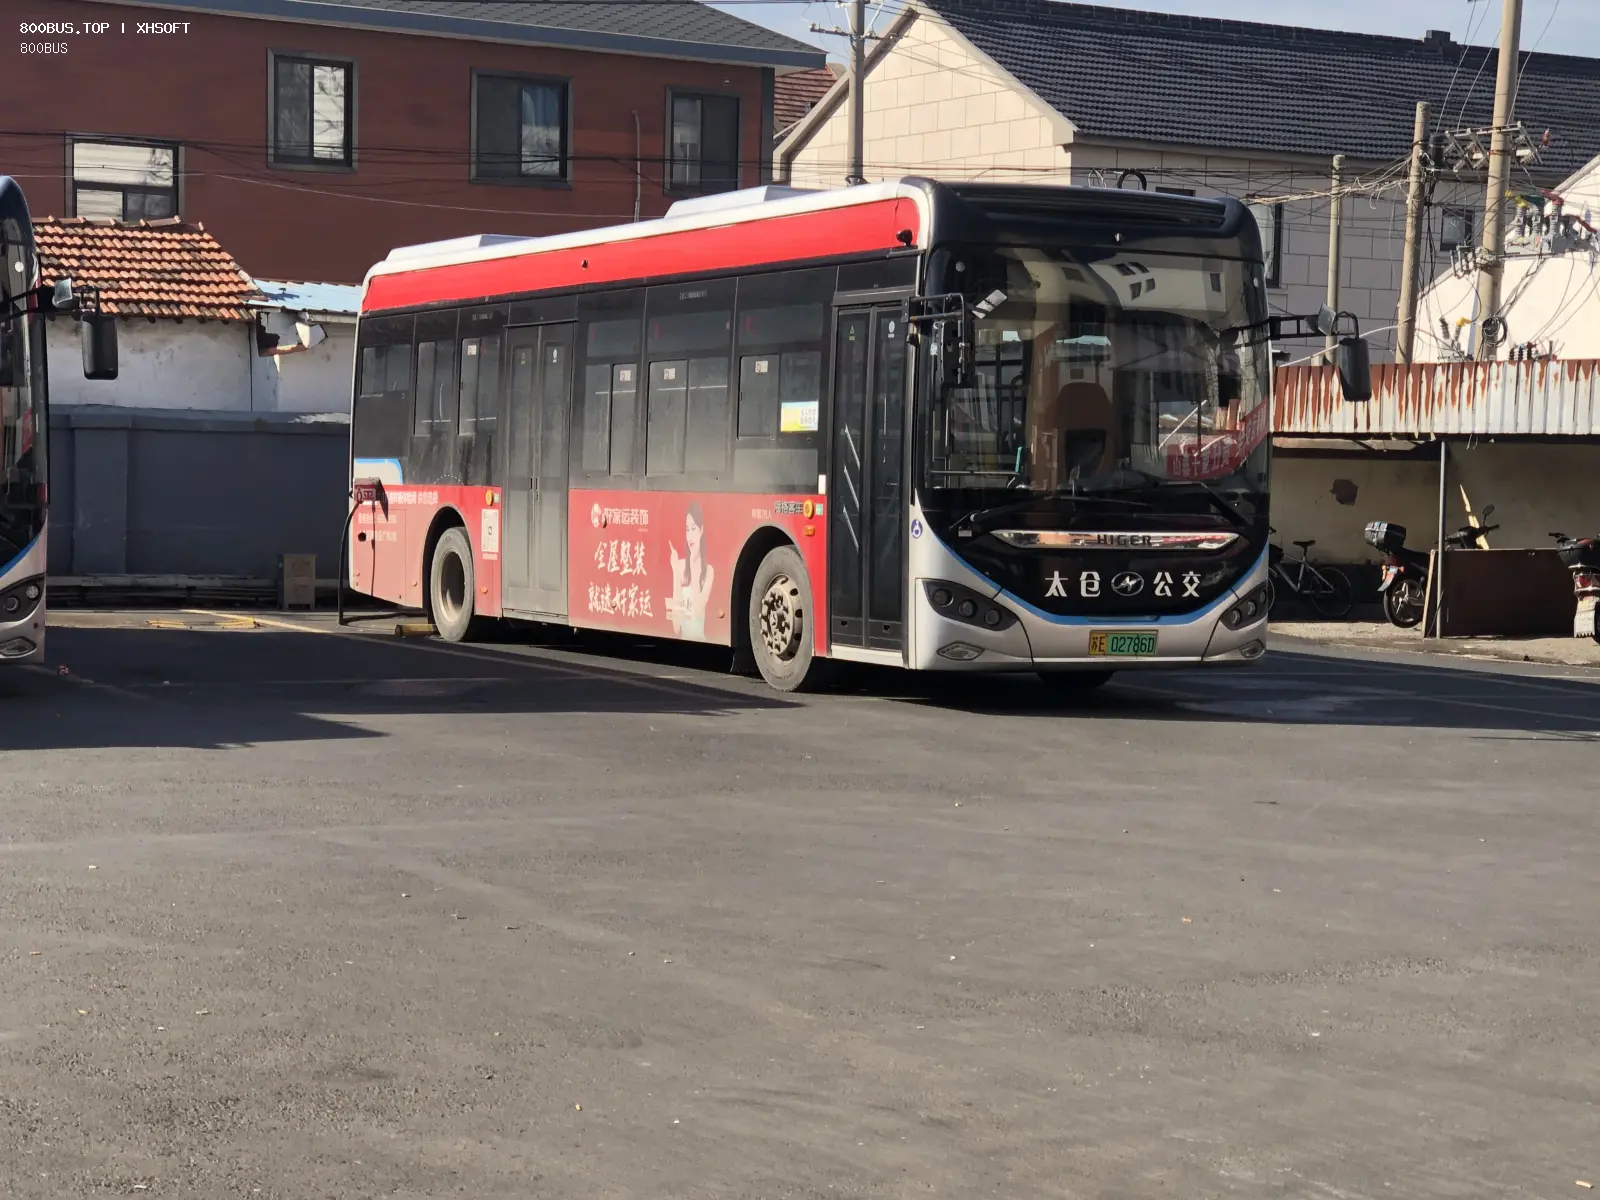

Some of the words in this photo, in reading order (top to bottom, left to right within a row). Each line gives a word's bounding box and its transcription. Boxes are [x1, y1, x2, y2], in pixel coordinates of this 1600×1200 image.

[602, 507, 648, 525] 好家运装饰
[1097, 534, 1152, 546] HIGER
[1044, 570, 1101, 598] 太仓
[1153, 570, 1202, 598] 公交
